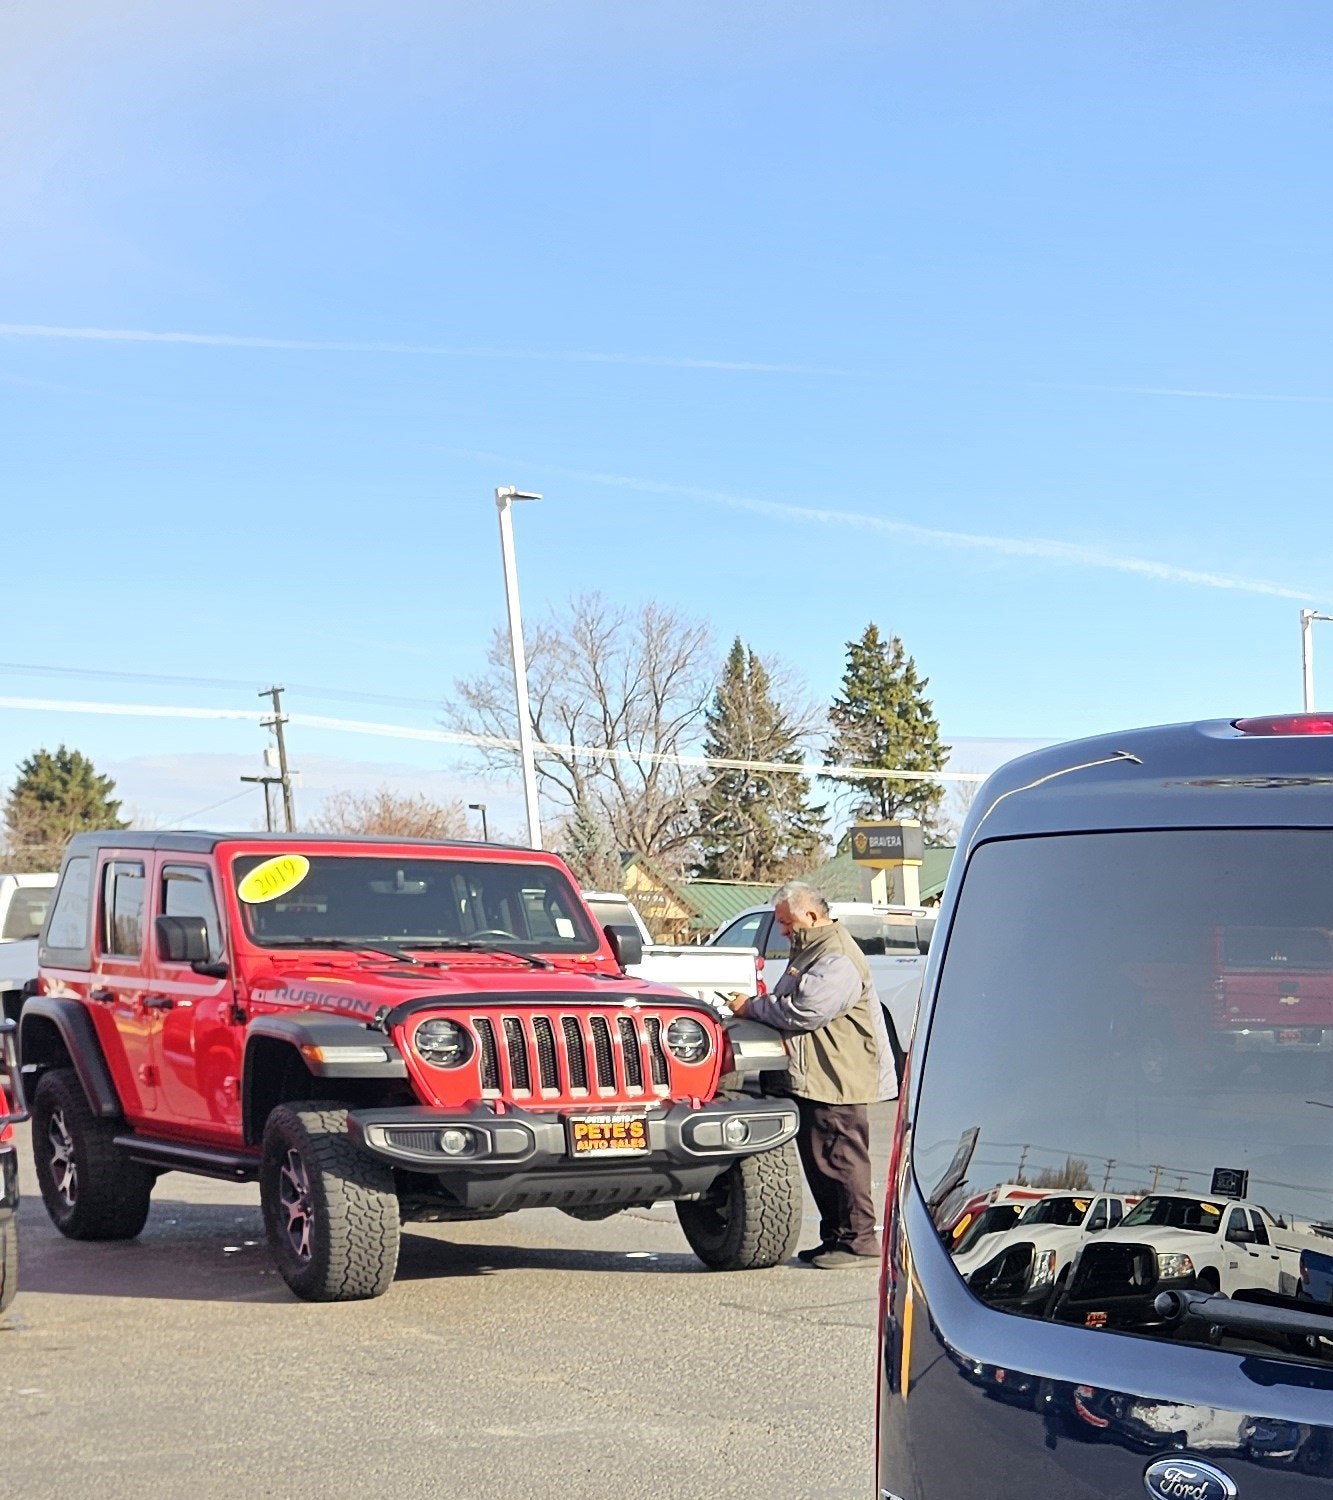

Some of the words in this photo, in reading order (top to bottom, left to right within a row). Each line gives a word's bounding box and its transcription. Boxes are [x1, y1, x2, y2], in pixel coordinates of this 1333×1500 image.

[869, 836, 902, 848] BRAVERA
[255, 859, 295, 895] 2019
[275, 987, 372, 1012] RUBICON
[574, 1121, 645, 1140] PETE'S
[576, 1140, 609, 1151] AUTO
[609, 1137, 647, 1149] SALES
